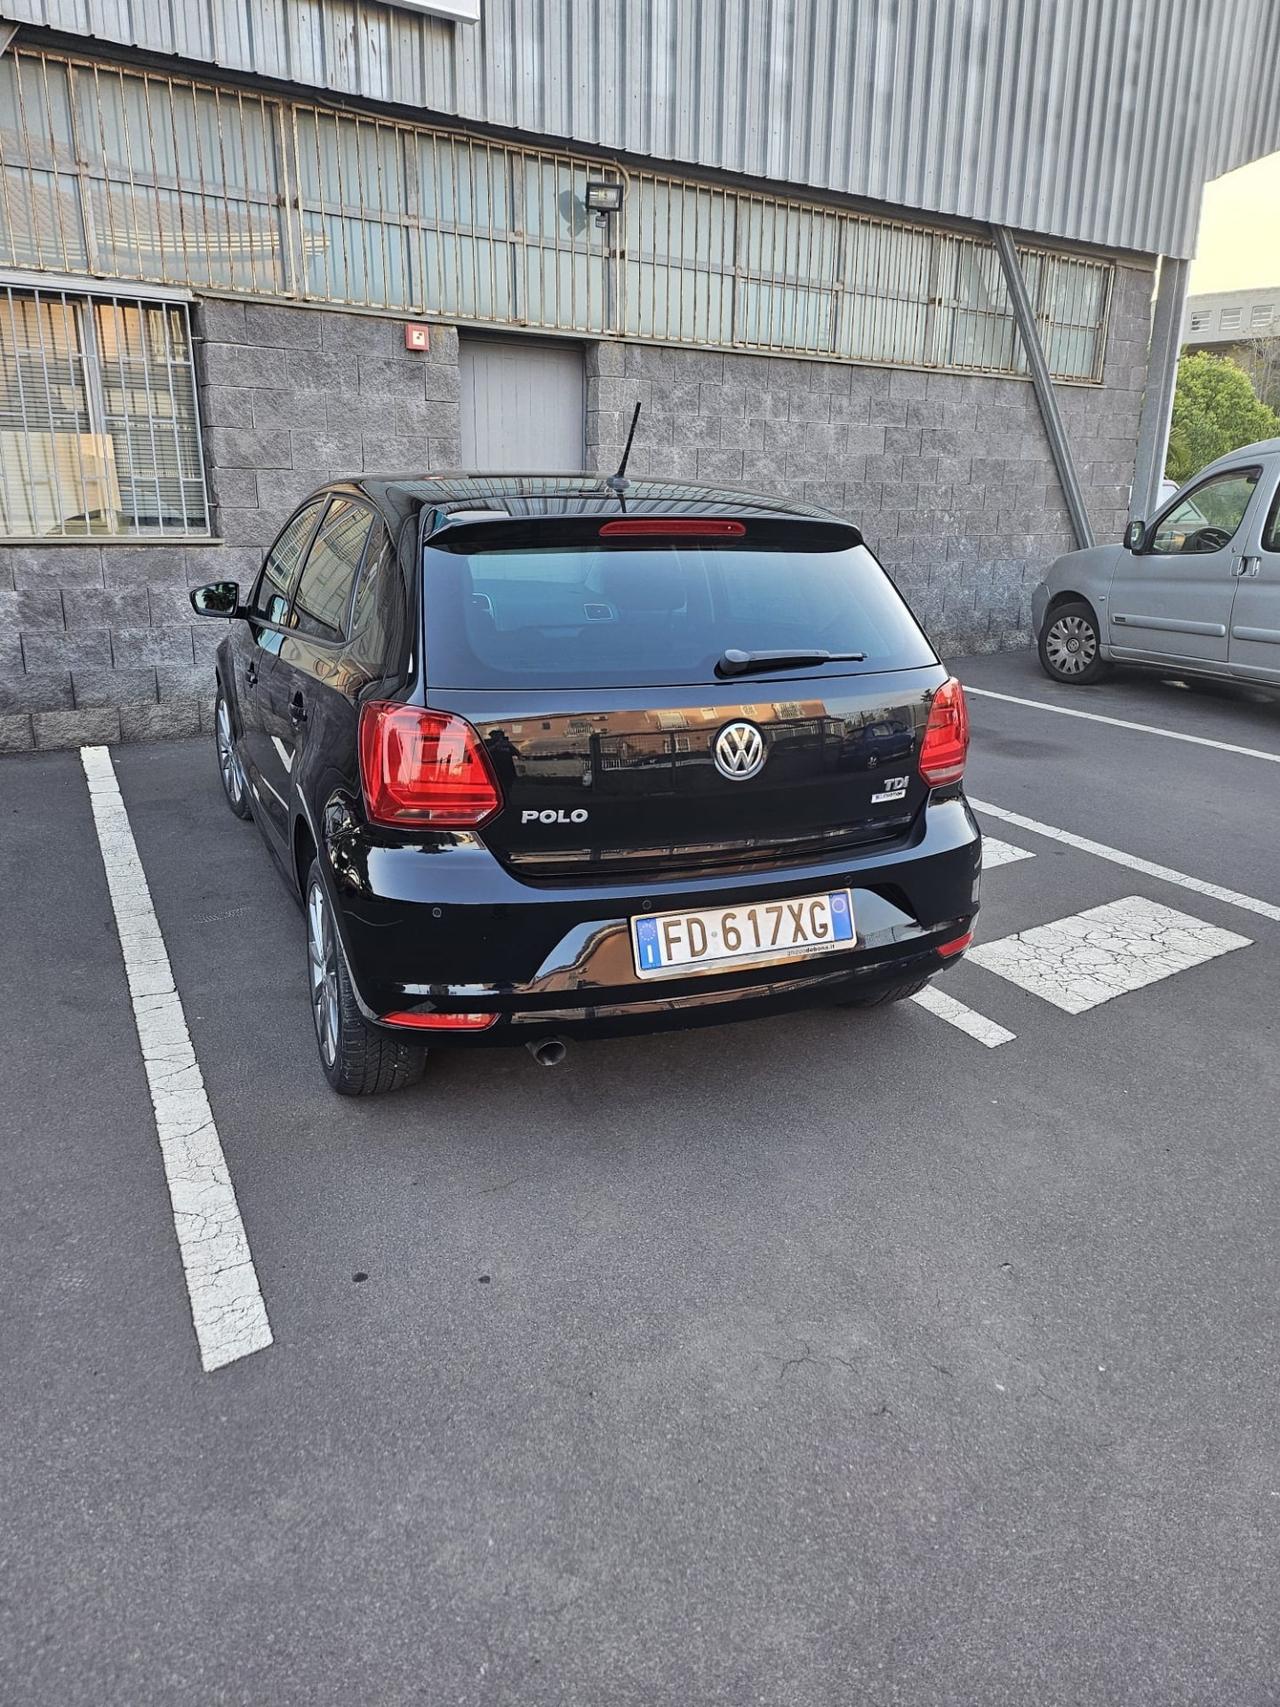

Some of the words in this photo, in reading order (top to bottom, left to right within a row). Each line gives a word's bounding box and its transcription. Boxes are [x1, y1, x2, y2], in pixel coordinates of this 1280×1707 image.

[716, 722, 763, 777] VW
[884, 775, 910, 791] TDI
[521, 809, 589, 824] POLO
[663, 918, 708, 961] FD
[721, 900, 828, 951] 617XG
